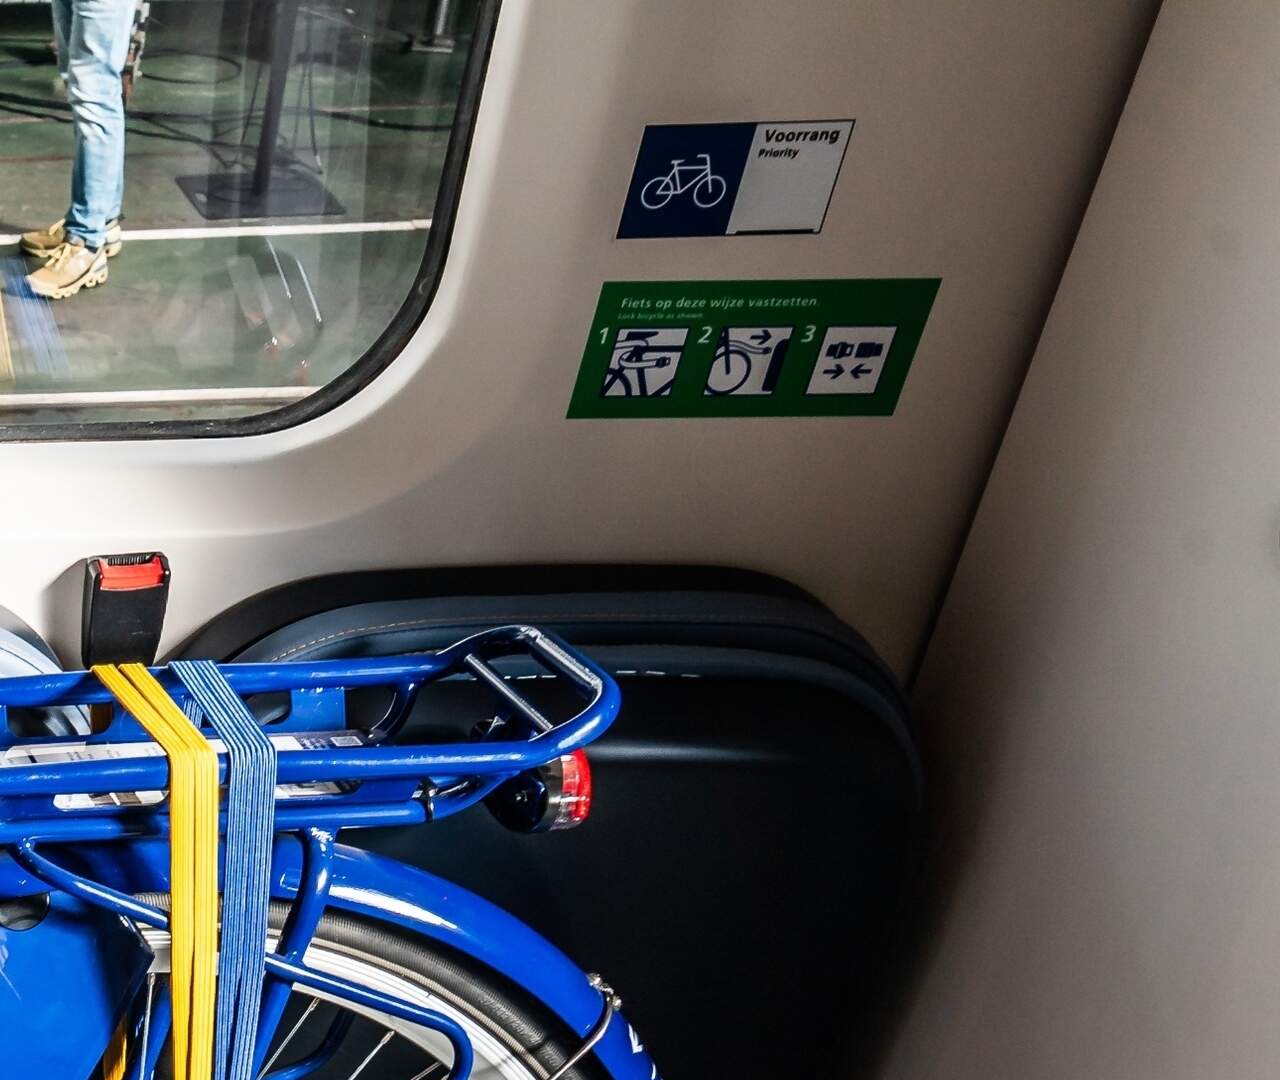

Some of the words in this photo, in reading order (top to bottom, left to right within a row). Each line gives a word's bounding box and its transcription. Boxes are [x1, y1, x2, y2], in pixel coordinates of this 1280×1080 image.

[764, 128, 841, 145] Voorrang
[758, 147, 800, 160] Priority
[621, 298, 651, 309] Fiets
[655, 300, 672, 310] op
[675, 298, 706, 308] deze
[710, 297, 744, 310] wijze
[599, 327, 609, 344] 1
[697, 326, 713, 344] 2
[801, 325, 817, 343] 3
